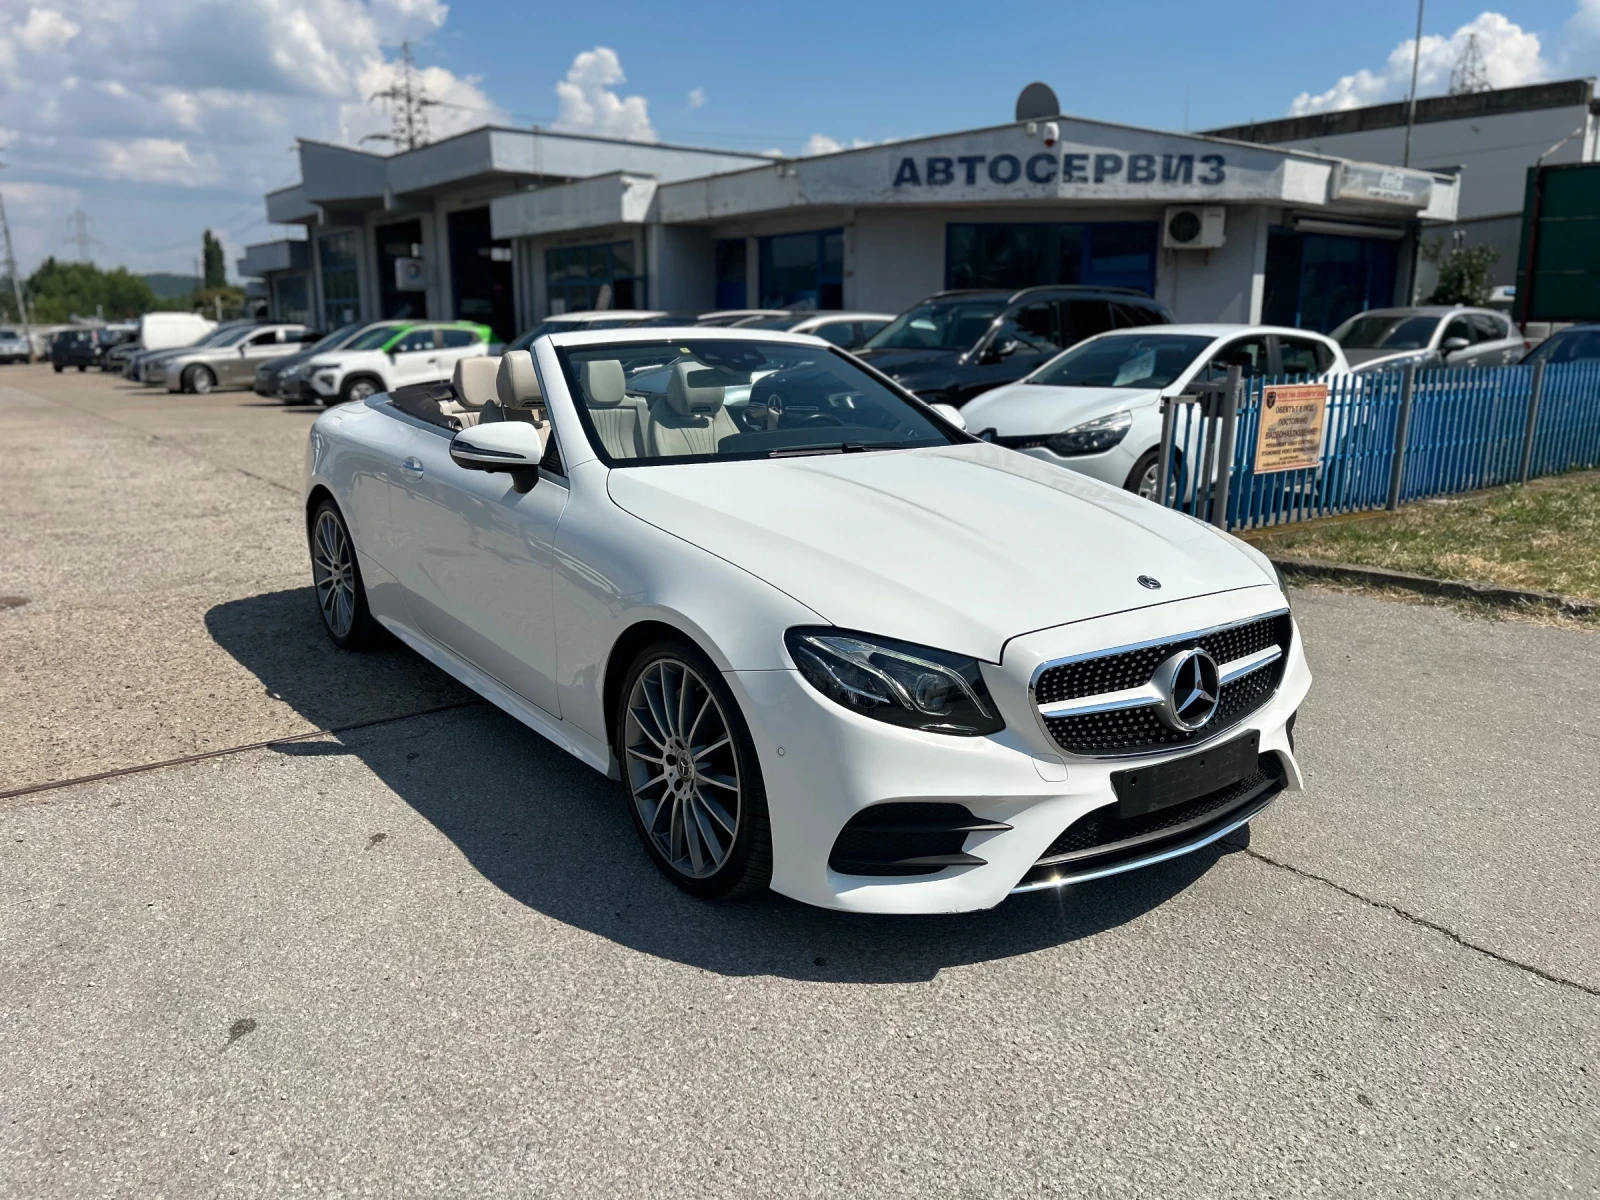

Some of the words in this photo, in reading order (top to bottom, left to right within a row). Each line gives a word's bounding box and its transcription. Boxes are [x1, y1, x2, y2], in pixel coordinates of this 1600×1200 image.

[892, 153, 1226, 187] АВТОСЕРВИЗ
[1276, 405, 1298, 414] ОБЕКТЪТ
[1278, 417, 1308, 426] ПОСТОЯННО
